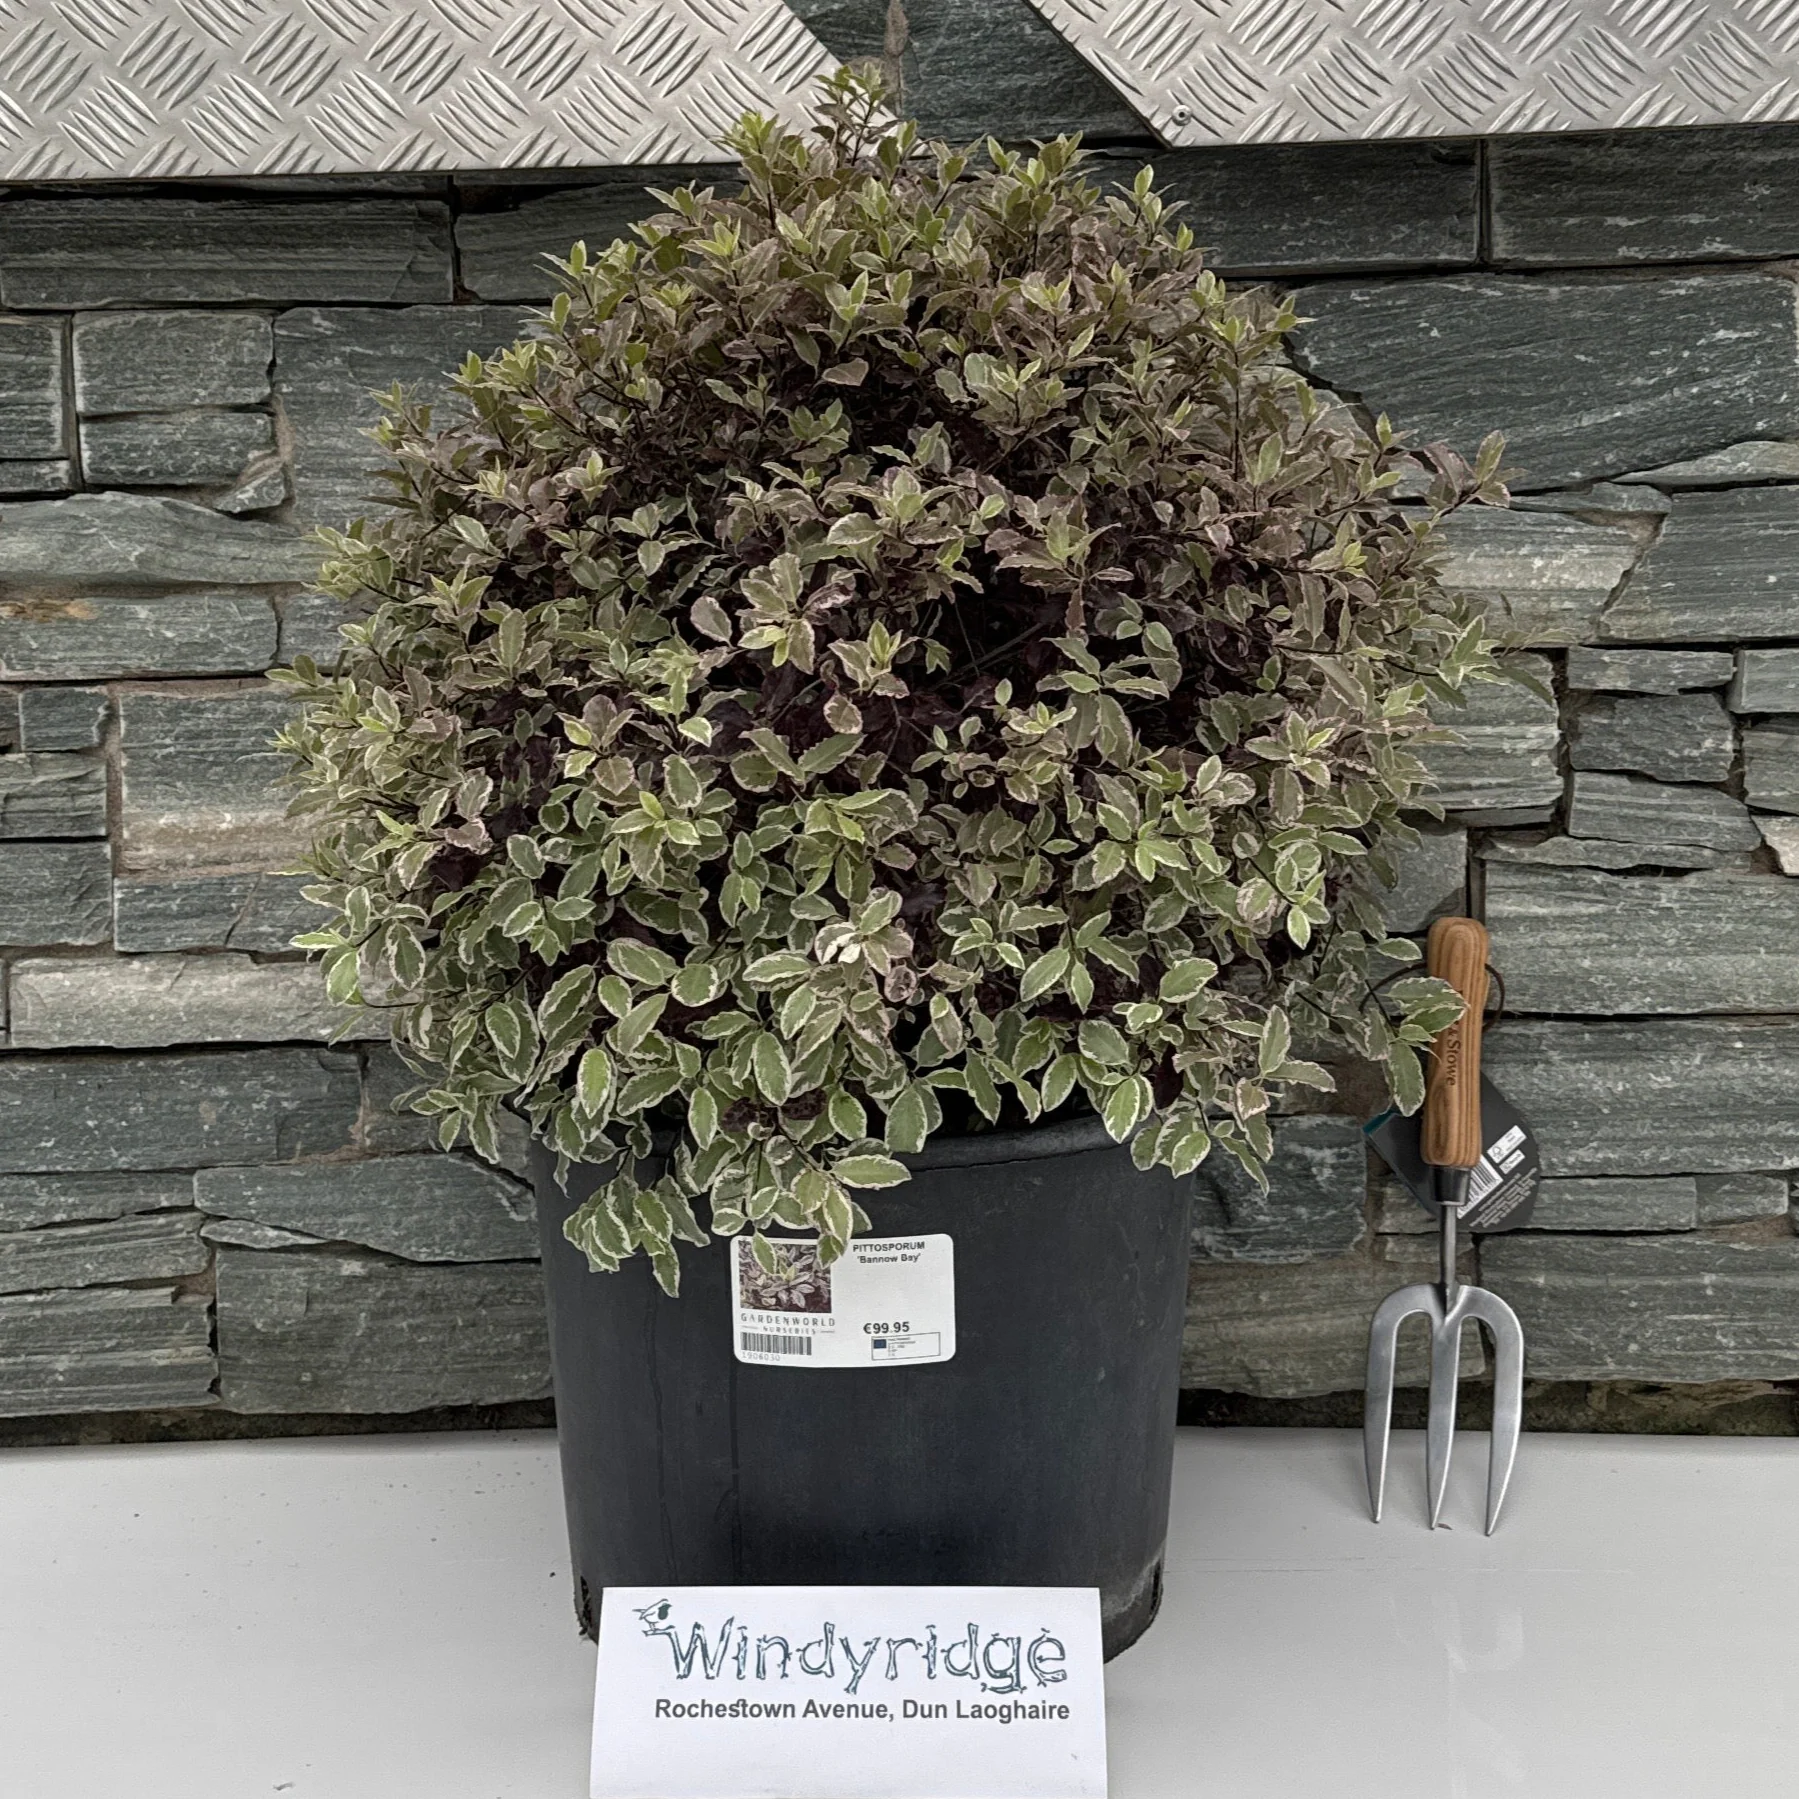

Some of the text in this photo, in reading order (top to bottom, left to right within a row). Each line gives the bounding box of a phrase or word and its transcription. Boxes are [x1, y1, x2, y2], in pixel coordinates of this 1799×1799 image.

[1446, 1039, 1462, 1086] Stowe
[852, 1241, 925, 1253] PITTOSPORUM
[856, 1253, 922, 1264] 'Bannow Bay'
[740, 1312, 836, 1327] GARDENWORLD
[763, 1326, 816, 1335] NURSERIES
[862, 1321, 911, 1335] €99.95
[643, 1615, 1069, 1695] Windyridge
[654, 1698, 1070, 1724] Rochestown Avenue, Dun Laoghaire
